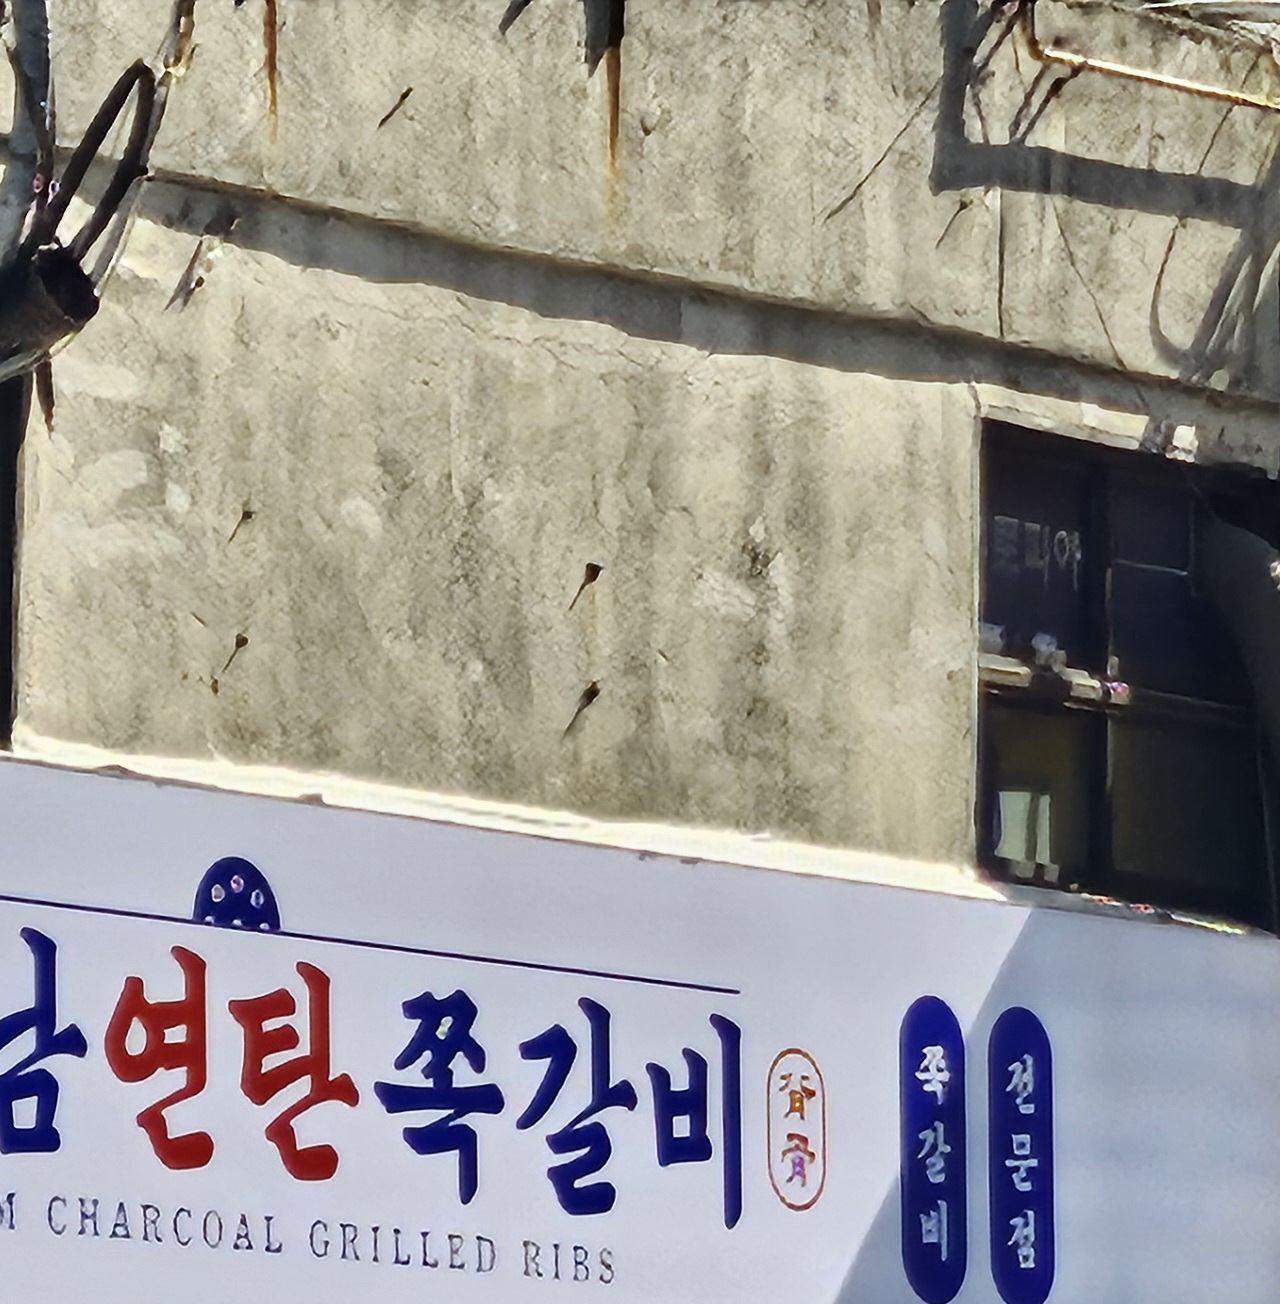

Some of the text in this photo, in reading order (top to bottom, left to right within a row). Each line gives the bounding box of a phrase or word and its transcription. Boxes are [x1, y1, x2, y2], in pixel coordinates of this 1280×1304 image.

[47, 1195, 283, 1255] CHARCOAL
[308, 1218, 496, 1275] GRILLED
[522, 1239, 617, 1285] RIBS
